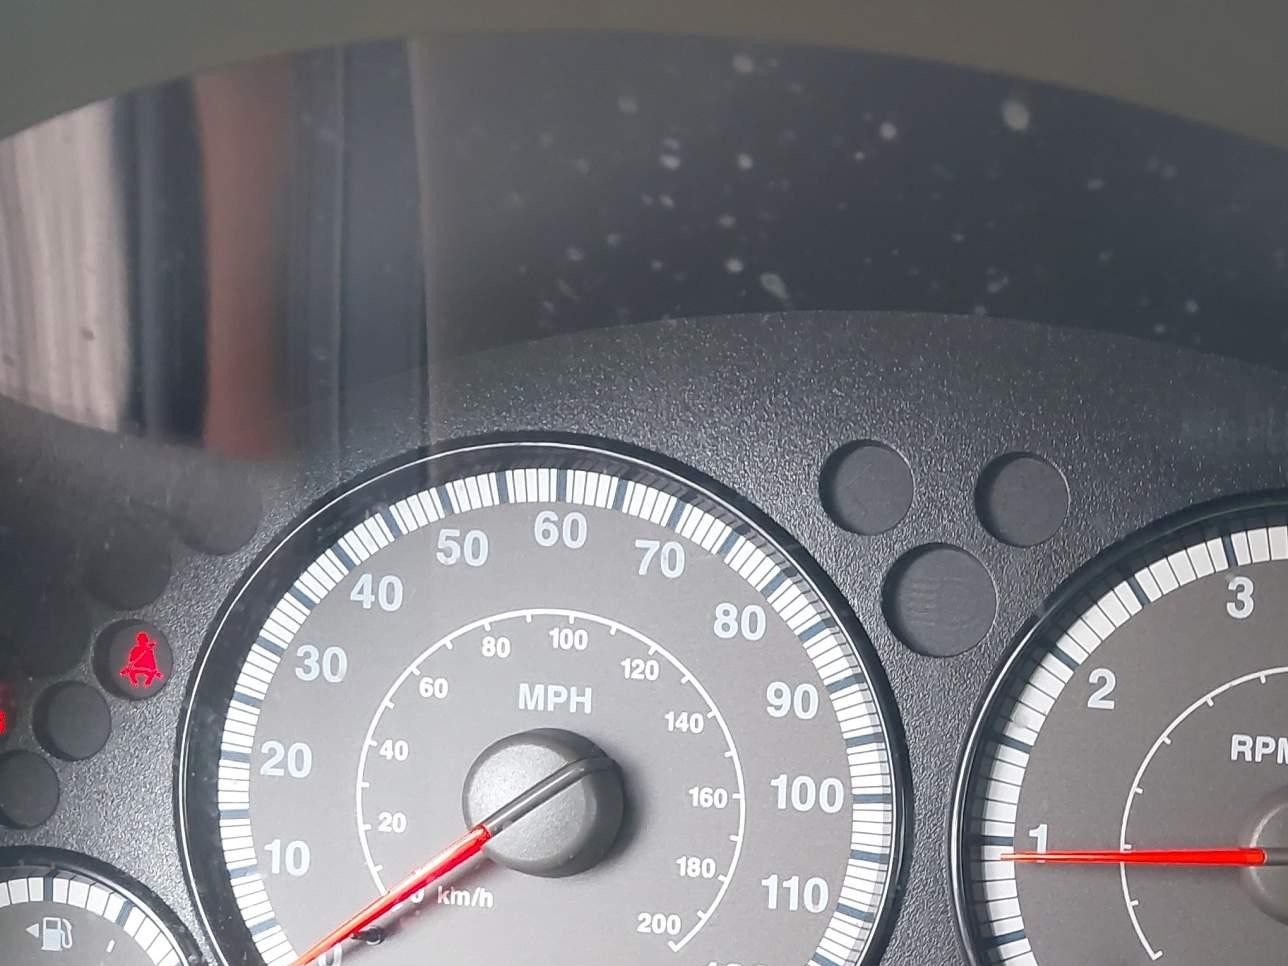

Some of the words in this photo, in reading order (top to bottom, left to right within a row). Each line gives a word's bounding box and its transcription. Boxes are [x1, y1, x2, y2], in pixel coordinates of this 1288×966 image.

[437, 529, 488, 566] 50
[535, 511, 587, 548] 60
[634, 532, 687, 578] 70
[351, 574, 403, 611] 40
[1227, 577, 1253, 618] 3
[549, 628, 588, 650] 100
[714, 603, 765, 640] 80
[296, 645, 347, 682] 30
[482, 636, 510, 657] 80
[621, 658, 659, 680] 120
[420, 677, 448, 698] 60
[519, 684, 591, 713] MPH
[767, 682, 818, 719] 90
[1088, 669, 1115, 709] 2
[665, 712, 703, 733] 140
[260, 741, 311, 777] 20
[380, 740, 408, 760] 40
[689, 787, 727, 808] 160
[771, 775, 843, 813] 100
[378, 812, 406, 832] 20
[264, 840, 310, 876] 10
[1029, 823, 1047, 863] 1
[676, 856, 715, 878] 180
[437, 885, 494, 908] km/h
[762, 875, 828, 912] 110
[636, 913, 682, 936] 200
